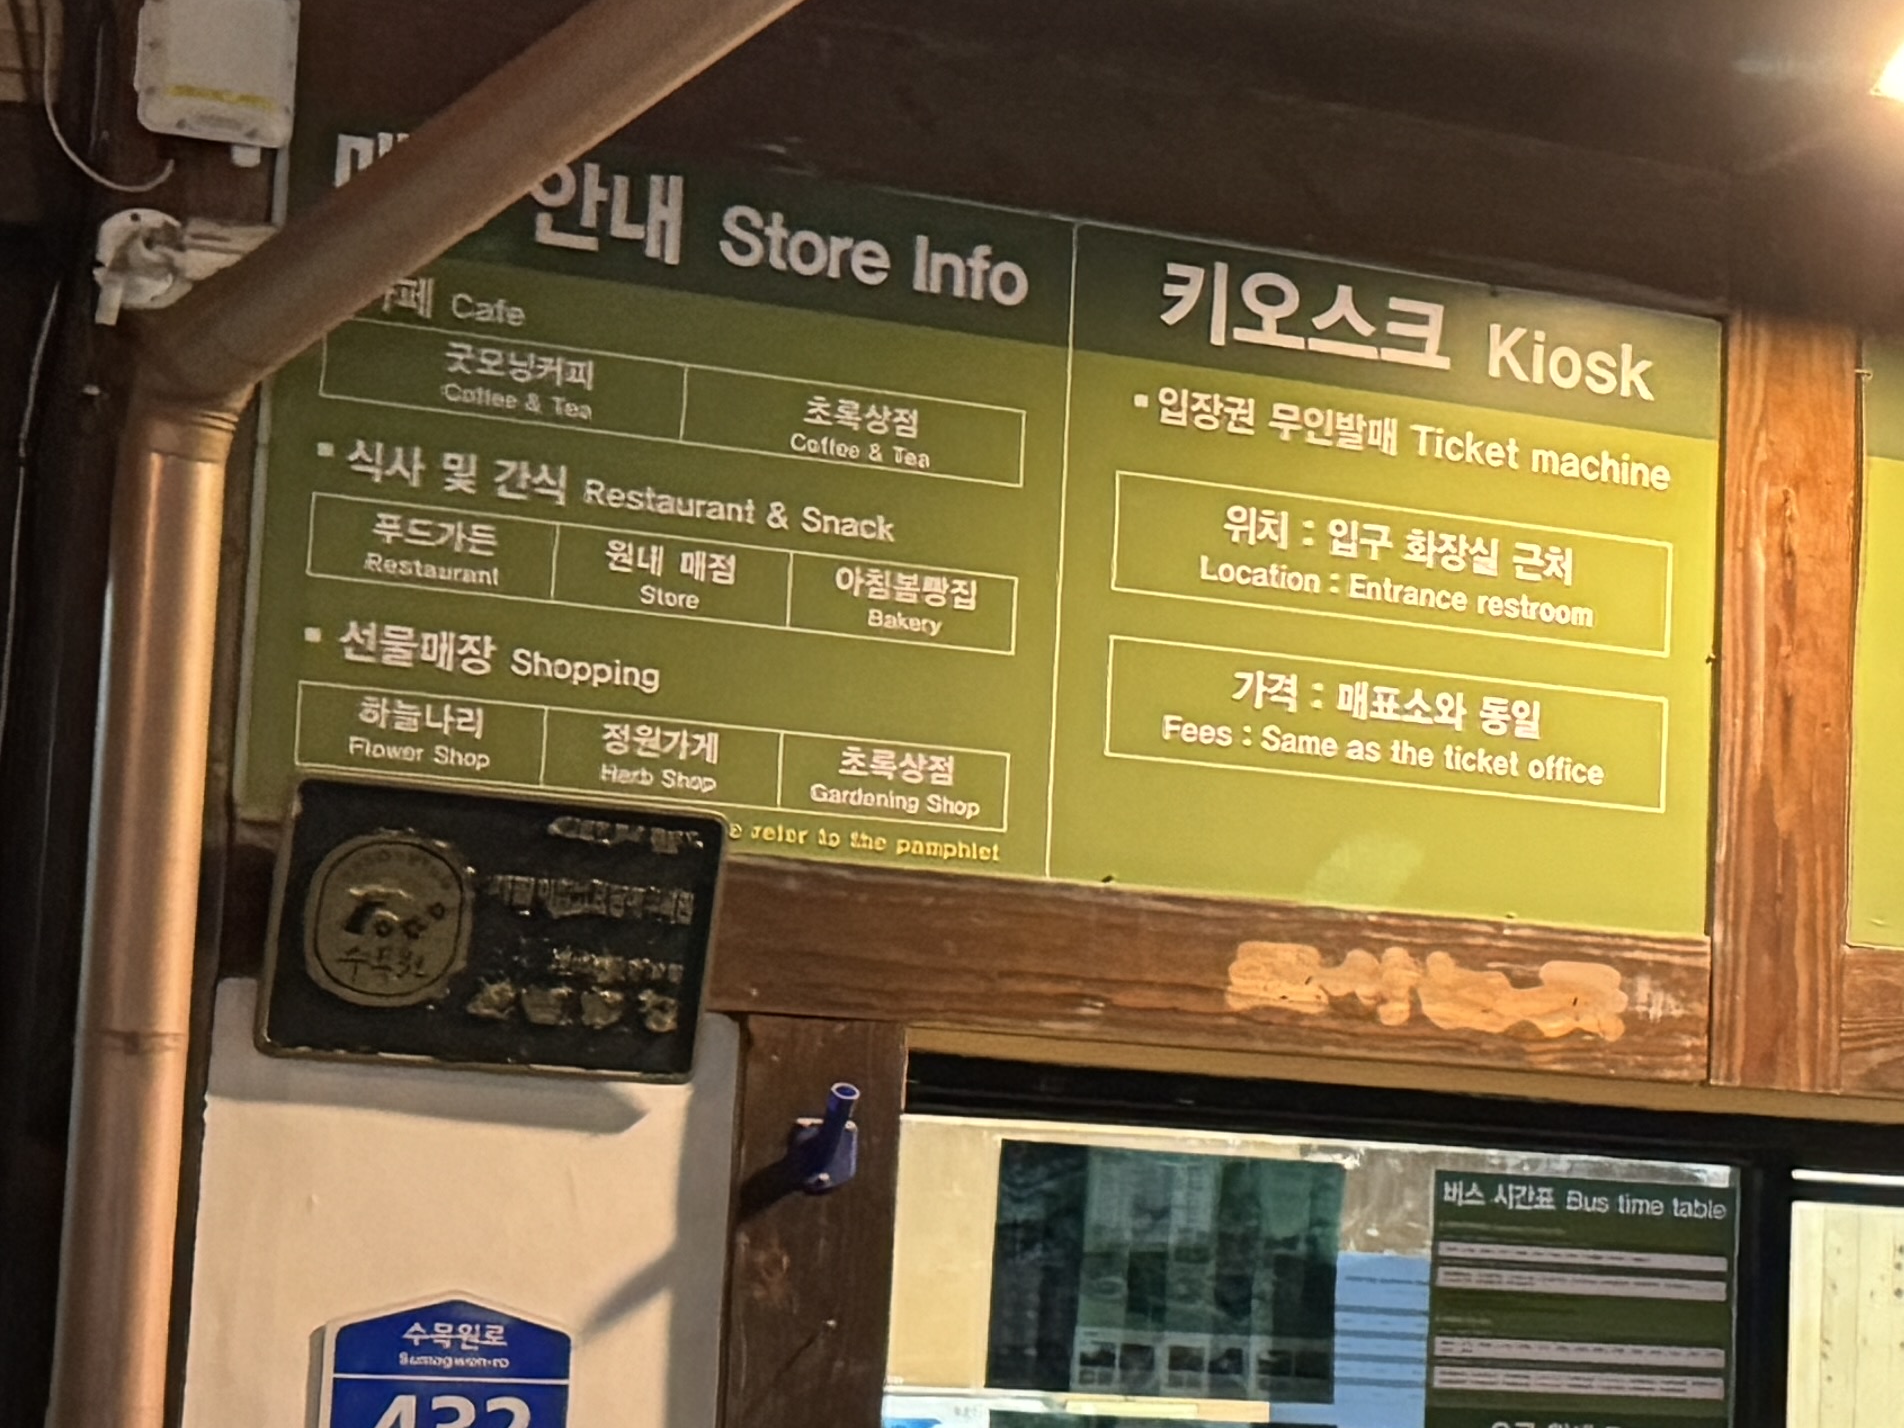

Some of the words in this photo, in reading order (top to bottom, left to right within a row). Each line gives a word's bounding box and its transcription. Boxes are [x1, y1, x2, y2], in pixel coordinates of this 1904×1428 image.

[529, 162, 685, 265] 안내
[719, 205, 890, 285] Store
[913, 234, 1028, 306] Info
[383, 276, 434, 318] 페
[451, 292, 525, 326] Cafe
[1160, 262, 1451, 371] 키오스크
[1488, 323, 1655, 401] Kiosk
[445, 341, 594, 391] 굿모닝커피
[803, 395, 918, 438] 초록상점
[1158, 387, 1255, 435] 입장권
[1267, 402, 1398, 456] 무인발매
[1409, 424, 1520, 470] Ticket
[1531, 448, 1675, 492] machine
[347, 439, 425, 487] 식사
[442, 452, 477, 494] 및
[494, 459, 567, 504] 간식
[583, 478, 755, 524] Restaurant
[801, 506, 895, 542] Snack
[372, 512, 498, 556] 푸드가든
[1223, 505, 1289, 550] 위치
[1326, 518, 1394, 561] 입구
[1400, 528, 1499, 577] 화장실
[1511, 541, 1572, 586] 근처
[360, 552, 499, 585] Restaurant
[605, 539, 663, 577] 원내
[680, 550, 736, 585] 매점
[636, 584, 699, 614] Store
[835, 566, 977, 611] 아침봄빵집
[1200, 554, 1321, 593] Location
[1345, 572, 1468, 612] Entrance
[1477, 593, 1593, 628] restroom
[867, 608, 942, 636] Bakery
[339, 621, 497, 675] 선물매장
[510, 648, 659, 693] Shopping
[358, 695, 483, 739] 하늘나리
[1232, 671, 1298, 713] 가격
[1335, 681, 1468, 732] 매표소와
[1477, 696, 1541, 740] 동일
[349, 736, 424, 762] Flower
[433, 744, 490, 771] Shop
[602, 723, 719, 764] 정원가게
[1162, 714, 1232, 746] Fees
[1259, 724, 1339, 757] Same
[1345, 739, 1381, 762] as
[1389, 739, 1434, 768] the
[1443, 743, 1520, 777] ticket
[1527, 754, 1605, 786] office
[600, 763, 654, 786] Herb
[661, 768, 717, 793] Shop
[838, 746, 954, 786] 초록상점
[810, 783, 919, 814] Gardening
[926, 793, 980, 819] Shop
[1443, 1180, 1485, 1206] 버스
[1493, 1183, 1555, 1210] 시간표
[1566, 1190, 1609, 1213] Bus
[1618, 1194, 1664, 1215] time
[1672, 1197, 1727, 1219] table
[402, 1322, 508, 1351] 수목원로
